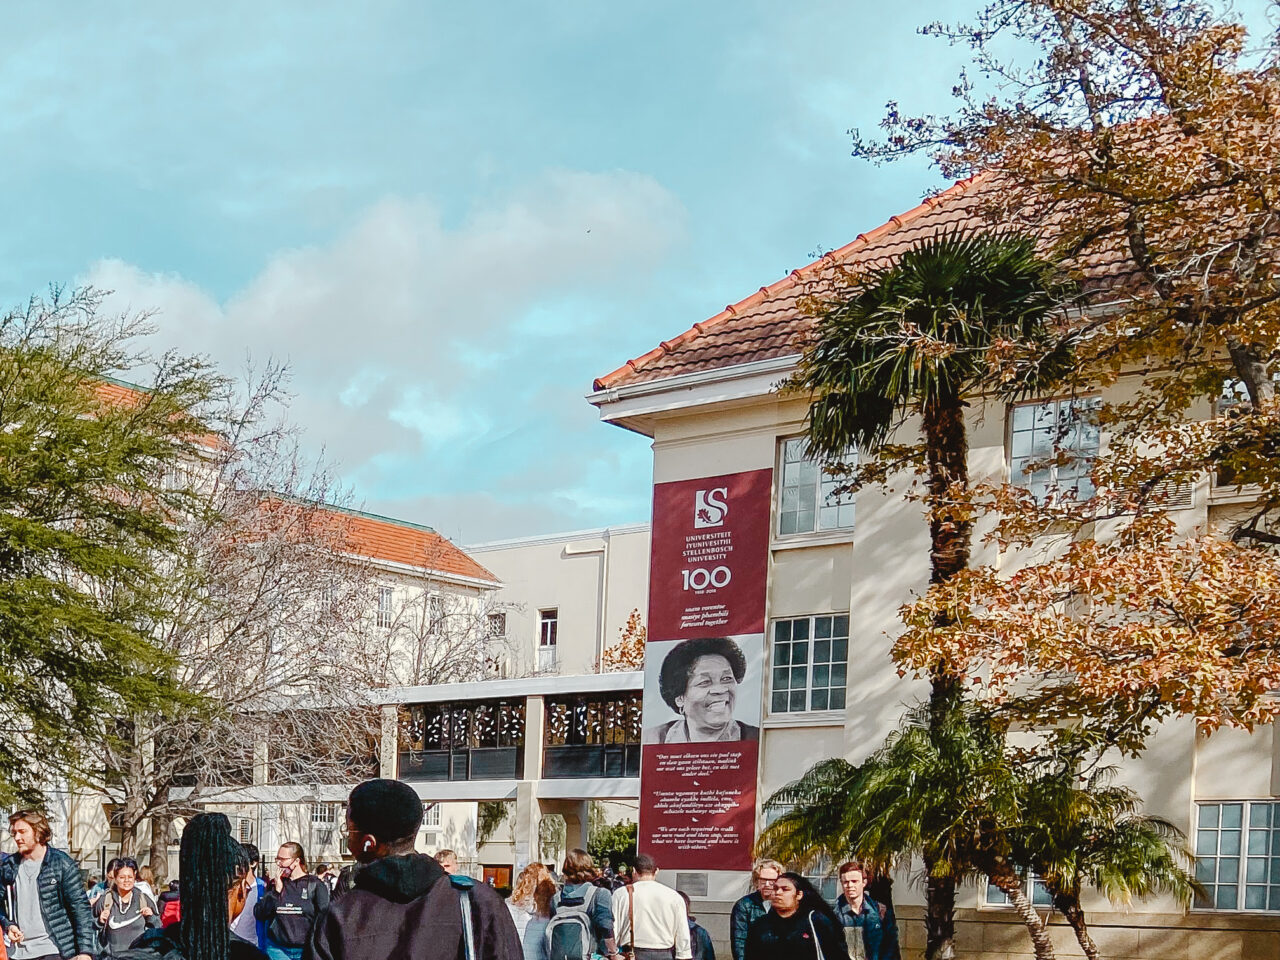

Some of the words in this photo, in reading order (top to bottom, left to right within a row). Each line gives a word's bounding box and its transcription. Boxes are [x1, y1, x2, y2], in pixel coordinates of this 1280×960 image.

[685, 531, 731, 542] UNIVERSITEIT
[682, 546, 733, 556] STELLENBOSCH
[688, 554, 727, 563] UNIVERSITY
[681, 566, 732, 590] 100
